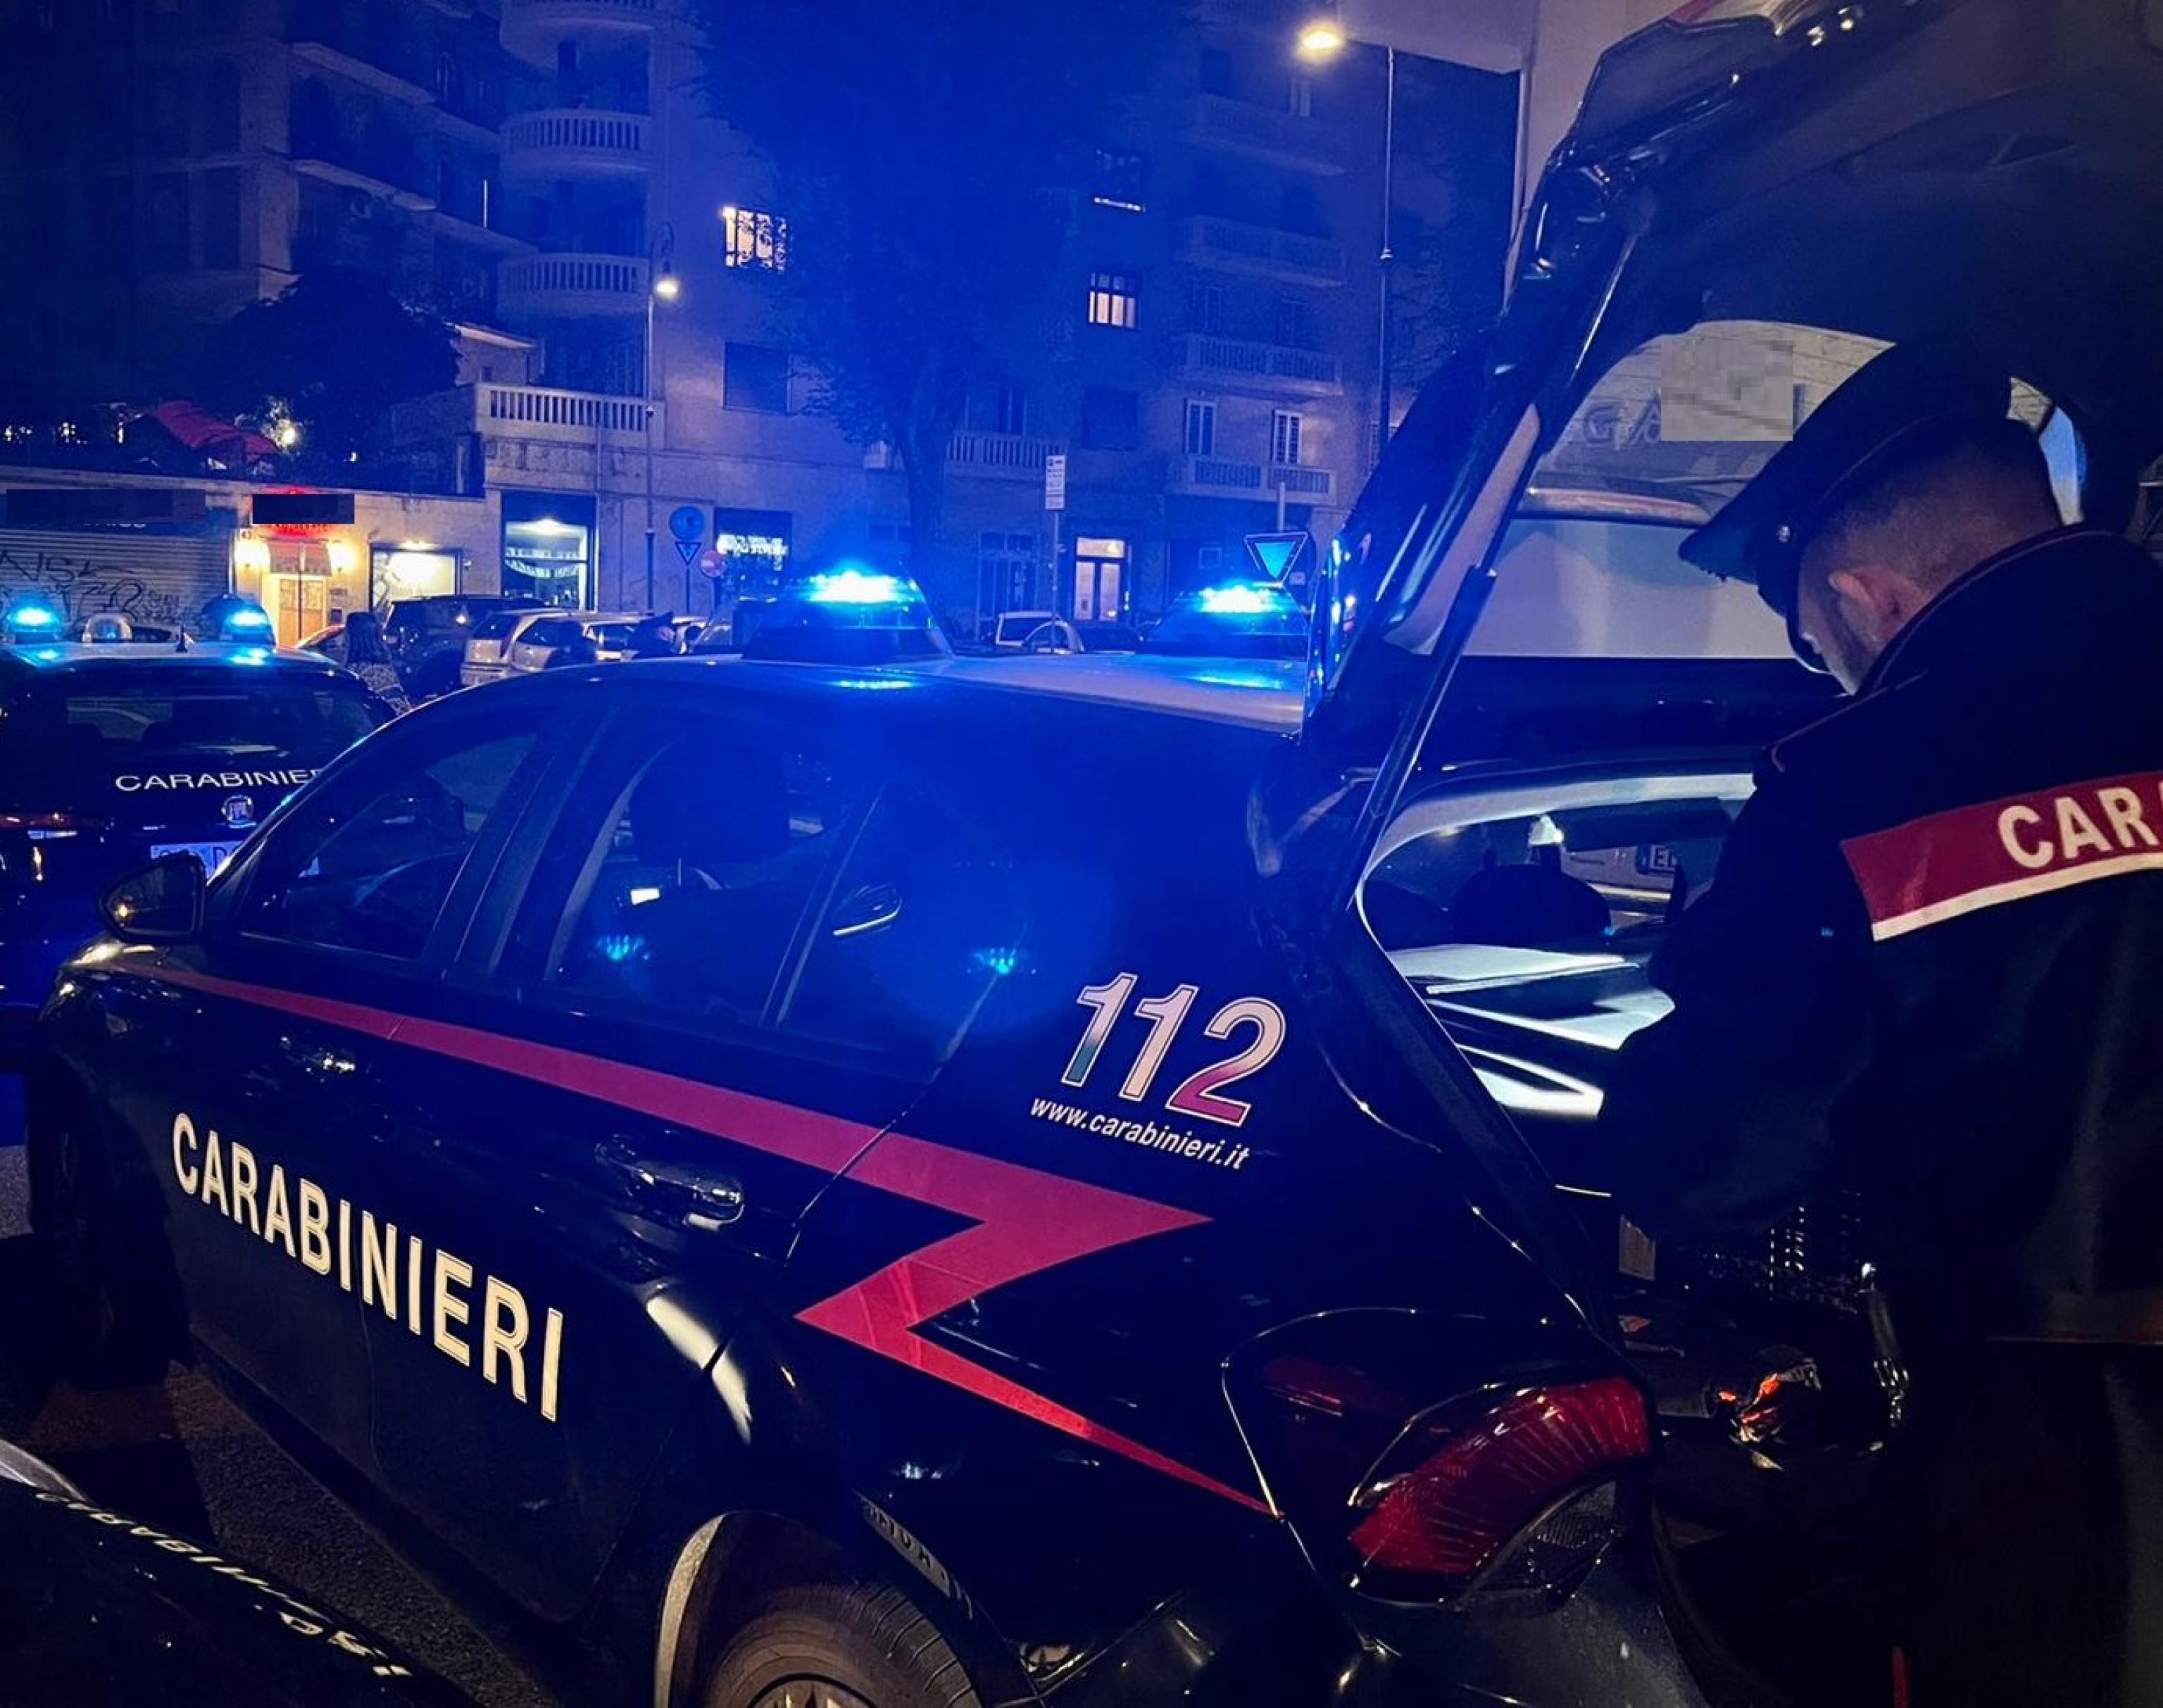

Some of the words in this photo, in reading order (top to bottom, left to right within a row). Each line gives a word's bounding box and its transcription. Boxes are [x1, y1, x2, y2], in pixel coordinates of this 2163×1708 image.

[1998, 781, 2163, 868] CAR
[1061, 972, 1286, 1127] 112
[1030, 1098, 1250, 1169] www.carabinieri.it
[173, 1112, 564, 1422] CARABINIERI
